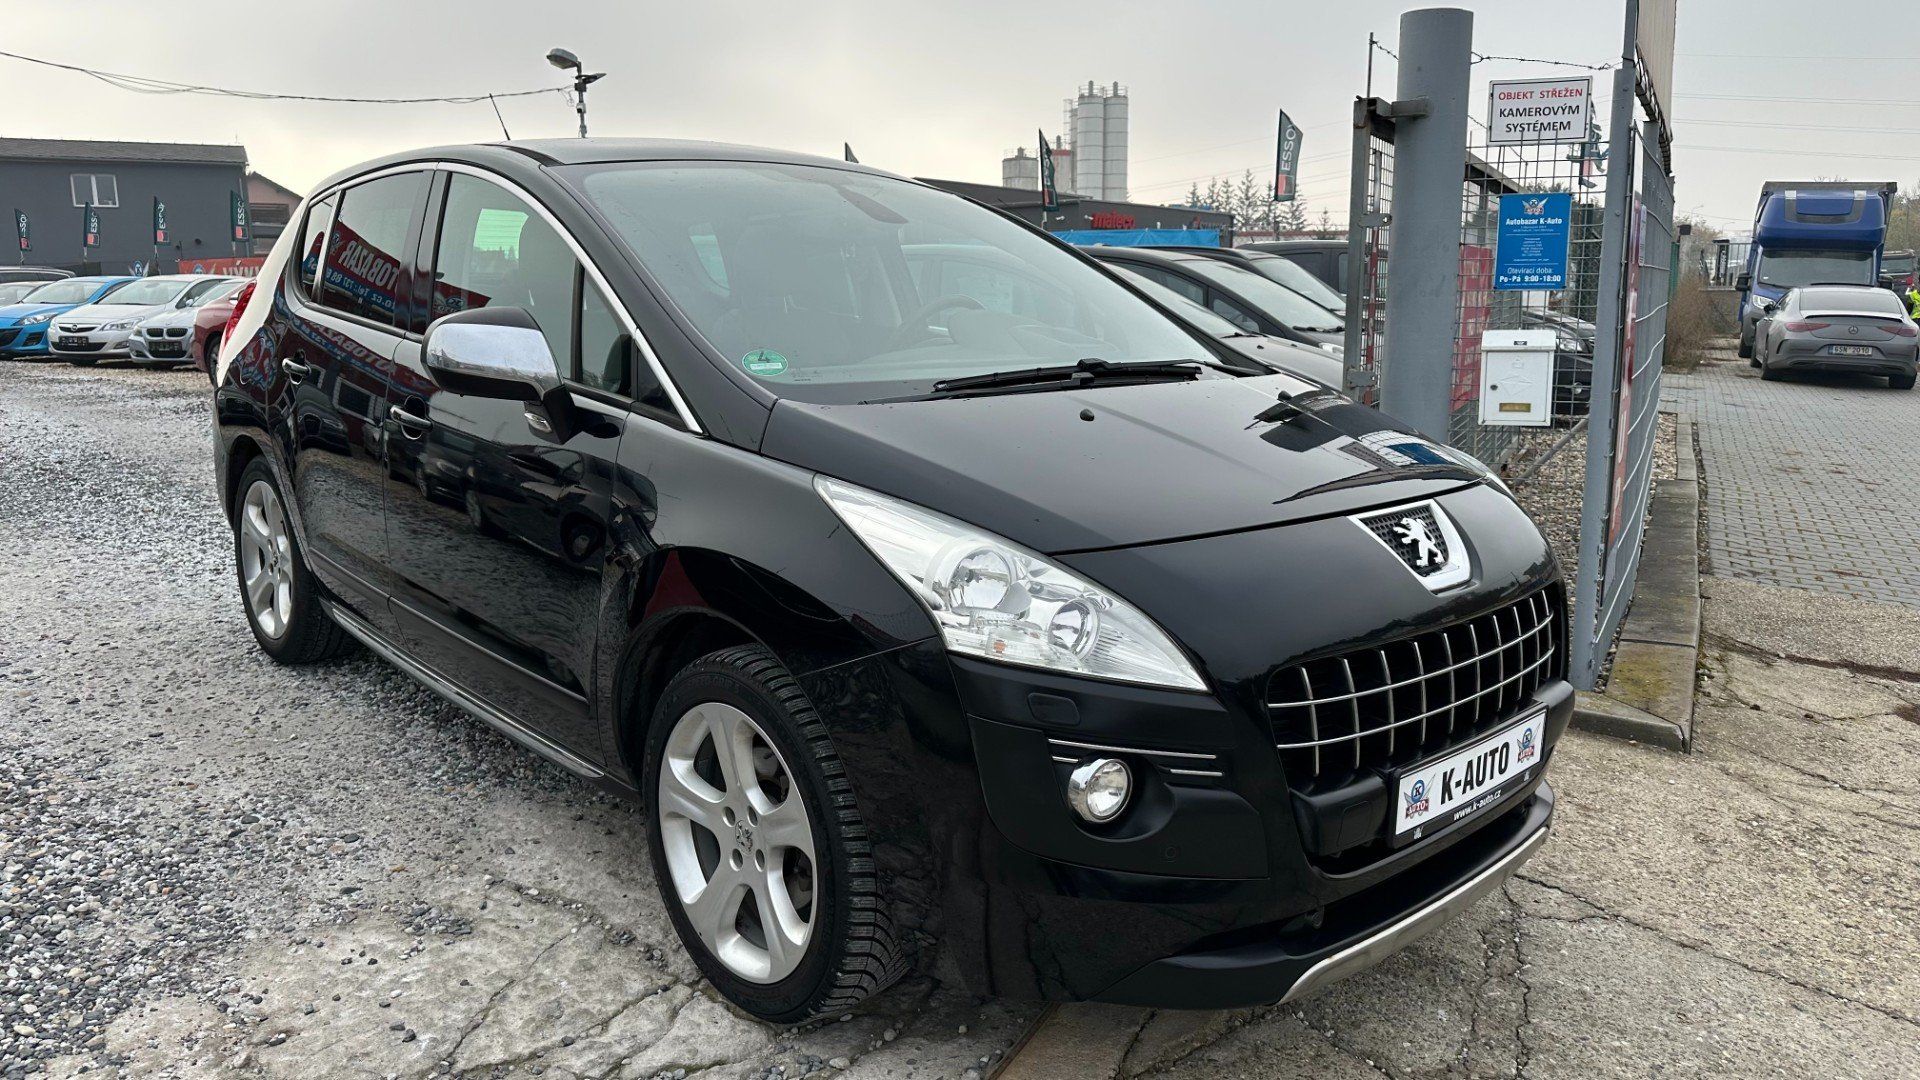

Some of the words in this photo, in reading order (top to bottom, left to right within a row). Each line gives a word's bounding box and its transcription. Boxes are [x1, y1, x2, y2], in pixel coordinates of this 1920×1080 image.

[1499, 91, 1534, 101] OBJEKT
[1540, 87, 1582, 99] STŘEŽEN
[1500, 103, 1580, 118] KAMEROVÝM
[1505, 120, 1571, 133] SYSTÉMEM
[1281, 124, 1297, 171] ESSO
[1506, 218, 1538, 226] Autobazar
[1540, 217, 1562, 225] K-Auto
[1441, 741, 1510, 806] K-AUTO
[1453, 789, 1502, 821] www.k-auto.cz
